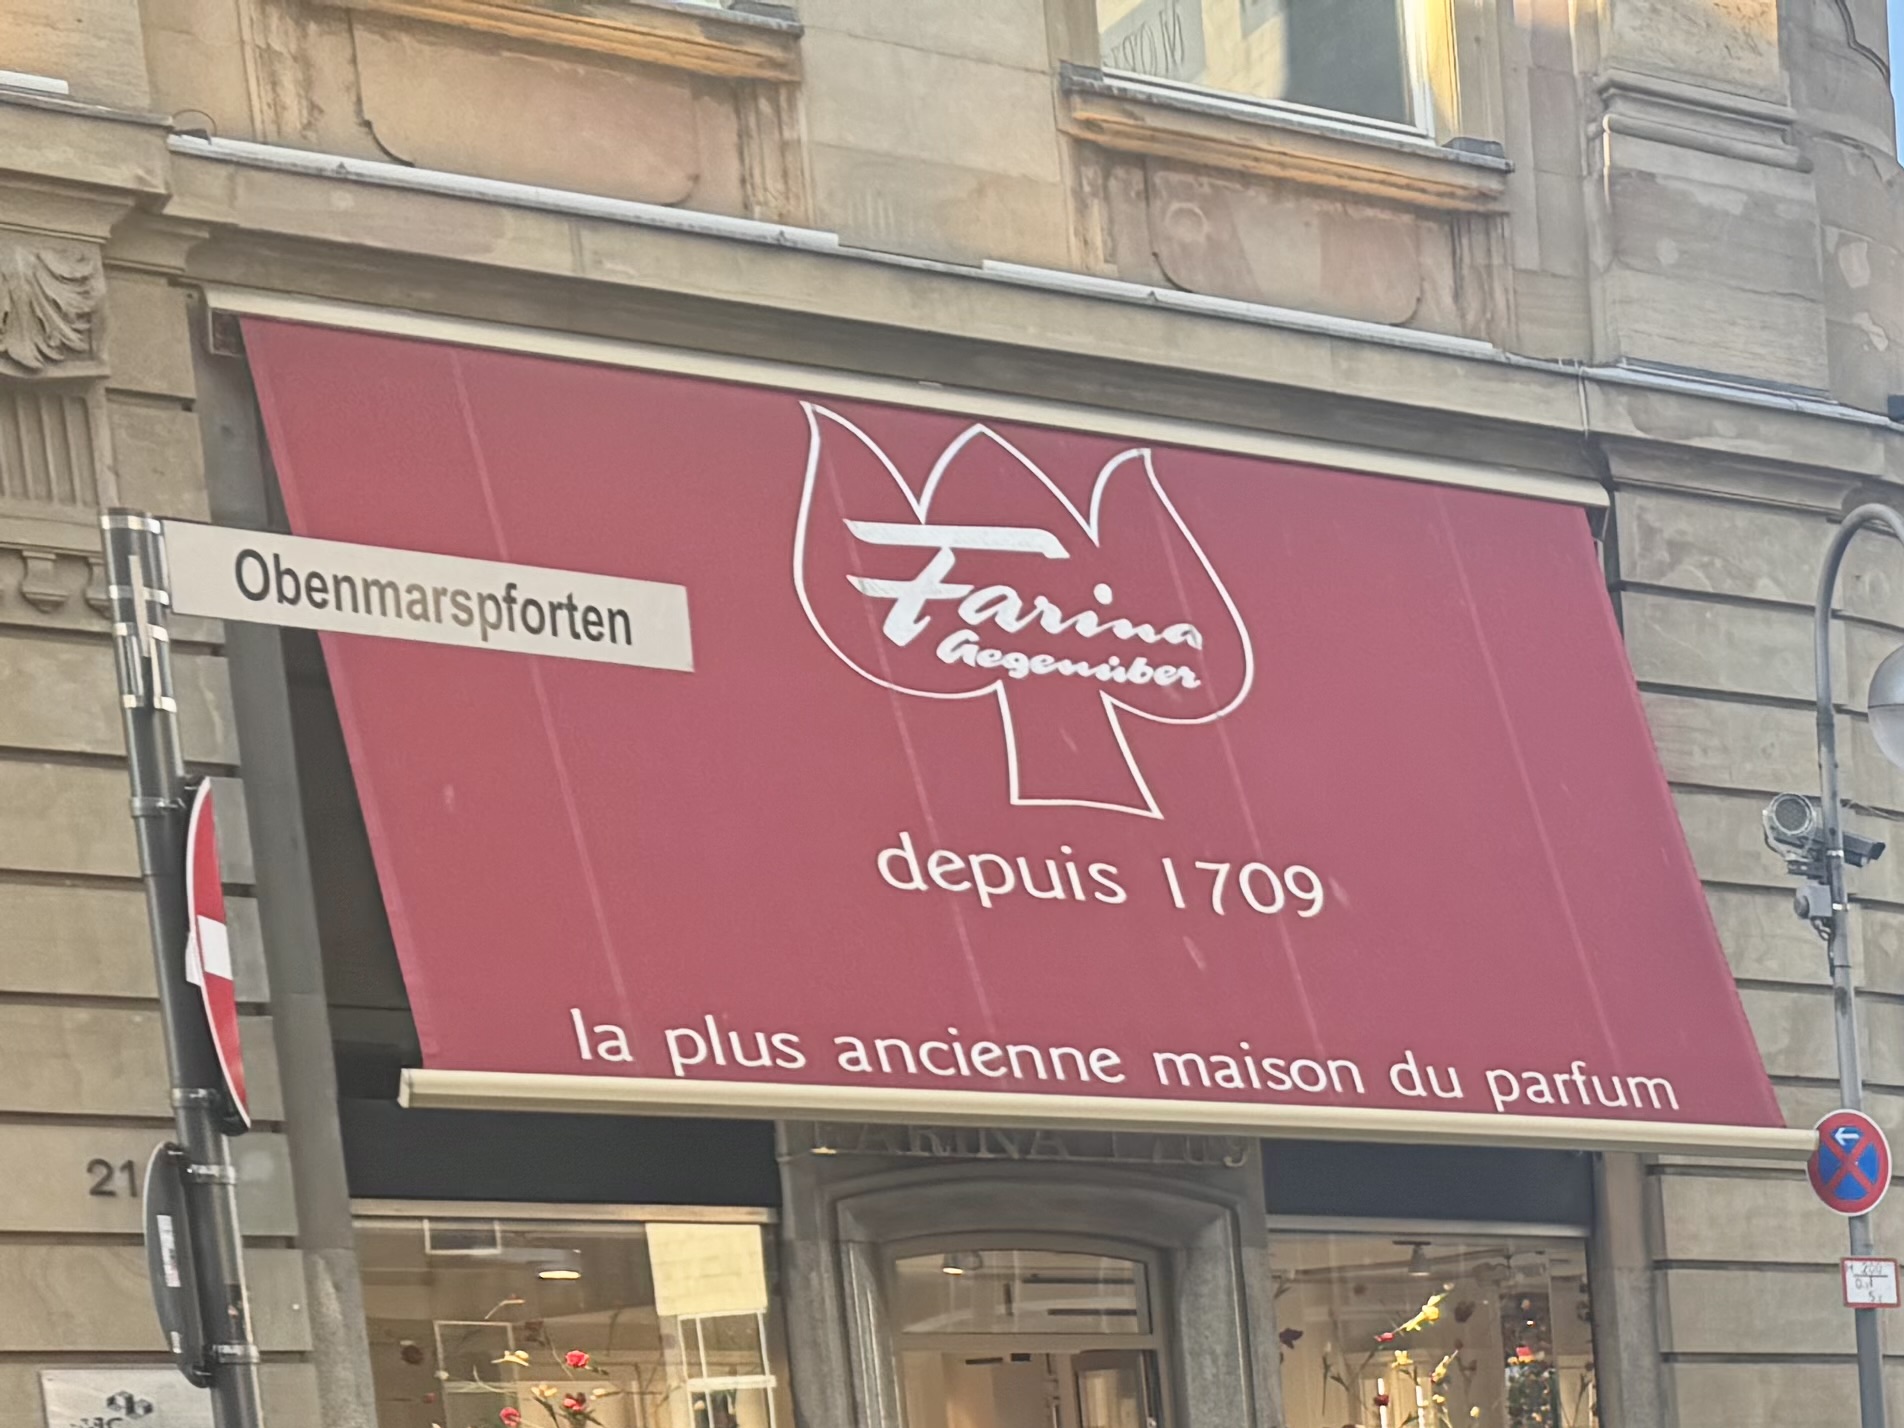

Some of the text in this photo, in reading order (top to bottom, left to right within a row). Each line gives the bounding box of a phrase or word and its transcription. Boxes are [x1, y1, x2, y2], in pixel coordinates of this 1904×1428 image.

[234, 548, 633, 647] Obenmarspforten
[844, 518, 1203, 650] Farina
[935, 634, 1201, 689] Gegenüber
[878, 831, 1325, 919] depuis 1709
[570, 1008, 1679, 1114] la plus ancienne maison du parfum
[87, 1159, 138, 1197] 21
